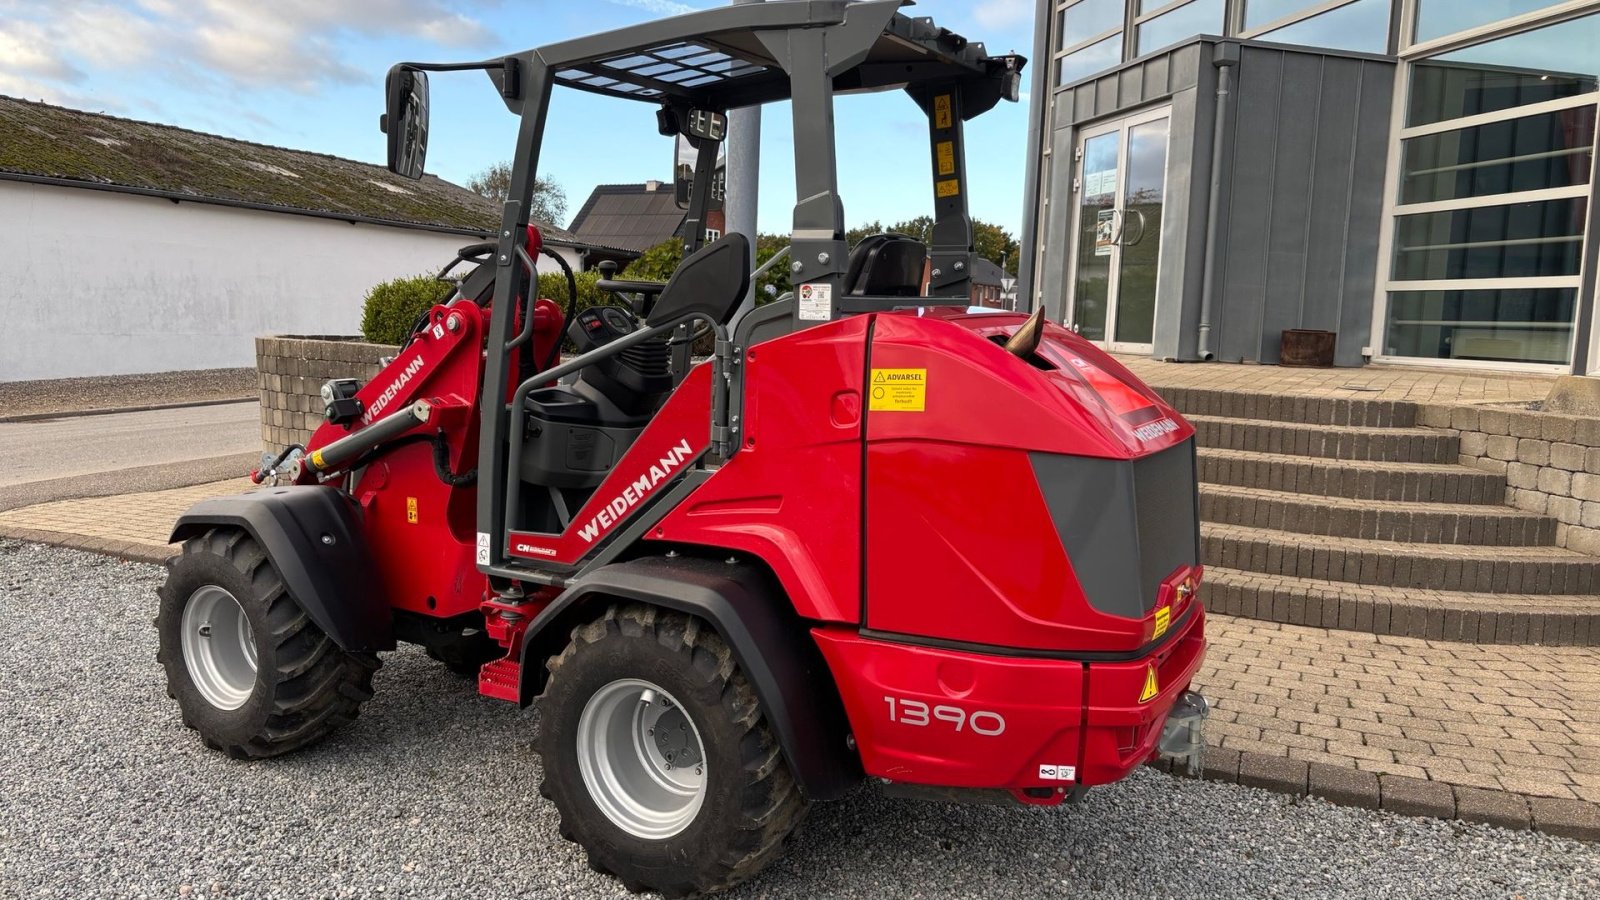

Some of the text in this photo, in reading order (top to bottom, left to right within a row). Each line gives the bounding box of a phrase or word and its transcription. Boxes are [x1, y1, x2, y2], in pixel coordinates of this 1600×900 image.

[361, 355, 424, 425] WEIDEMANN
[887, 373, 922, 381] ADVARSEL
[1134, 418, 1180, 442] WEIDEMANN
[577, 439, 693, 543] WEIDEMANN
[884, 696, 1006, 736] 1390
